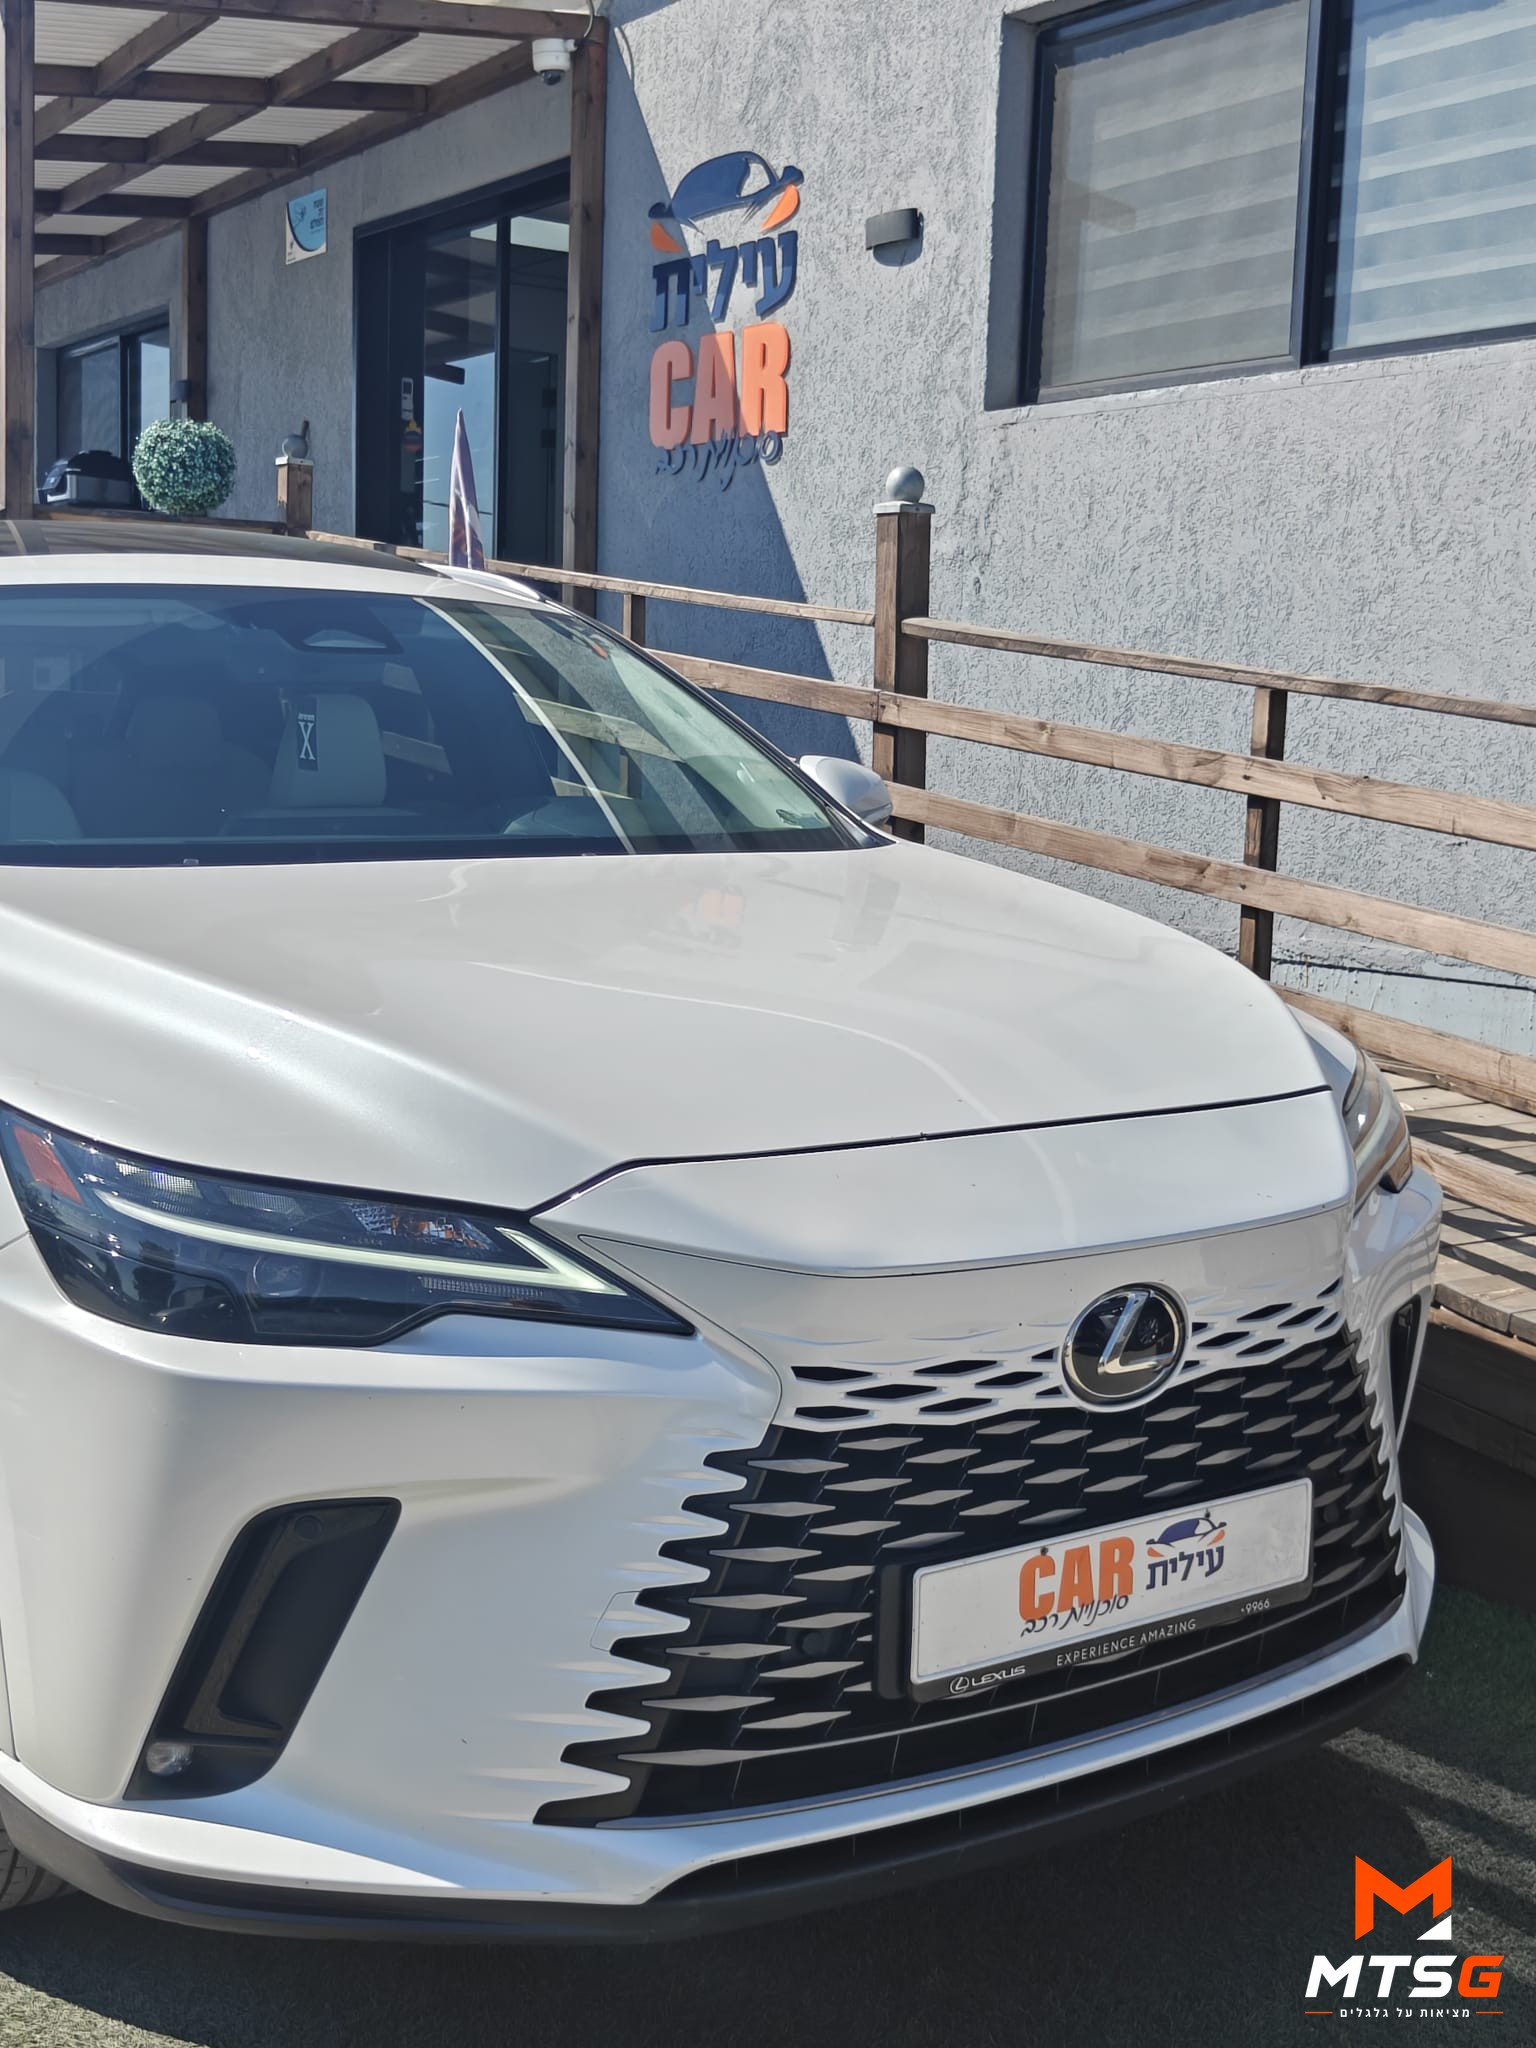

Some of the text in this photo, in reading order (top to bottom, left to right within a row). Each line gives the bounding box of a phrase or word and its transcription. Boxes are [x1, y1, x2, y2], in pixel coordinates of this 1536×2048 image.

[649, 230, 798, 332] עילית
[648, 321, 790, 451] CAR
[1018, 1536, 1225, 1620] CAR עילית
[1020, 1613, 1058, 1637] רכב
[1056, 1618, 1197, 1667] EXPERIENCE AMAZING
[971, 1665, 1026, 1686] LEXUS
